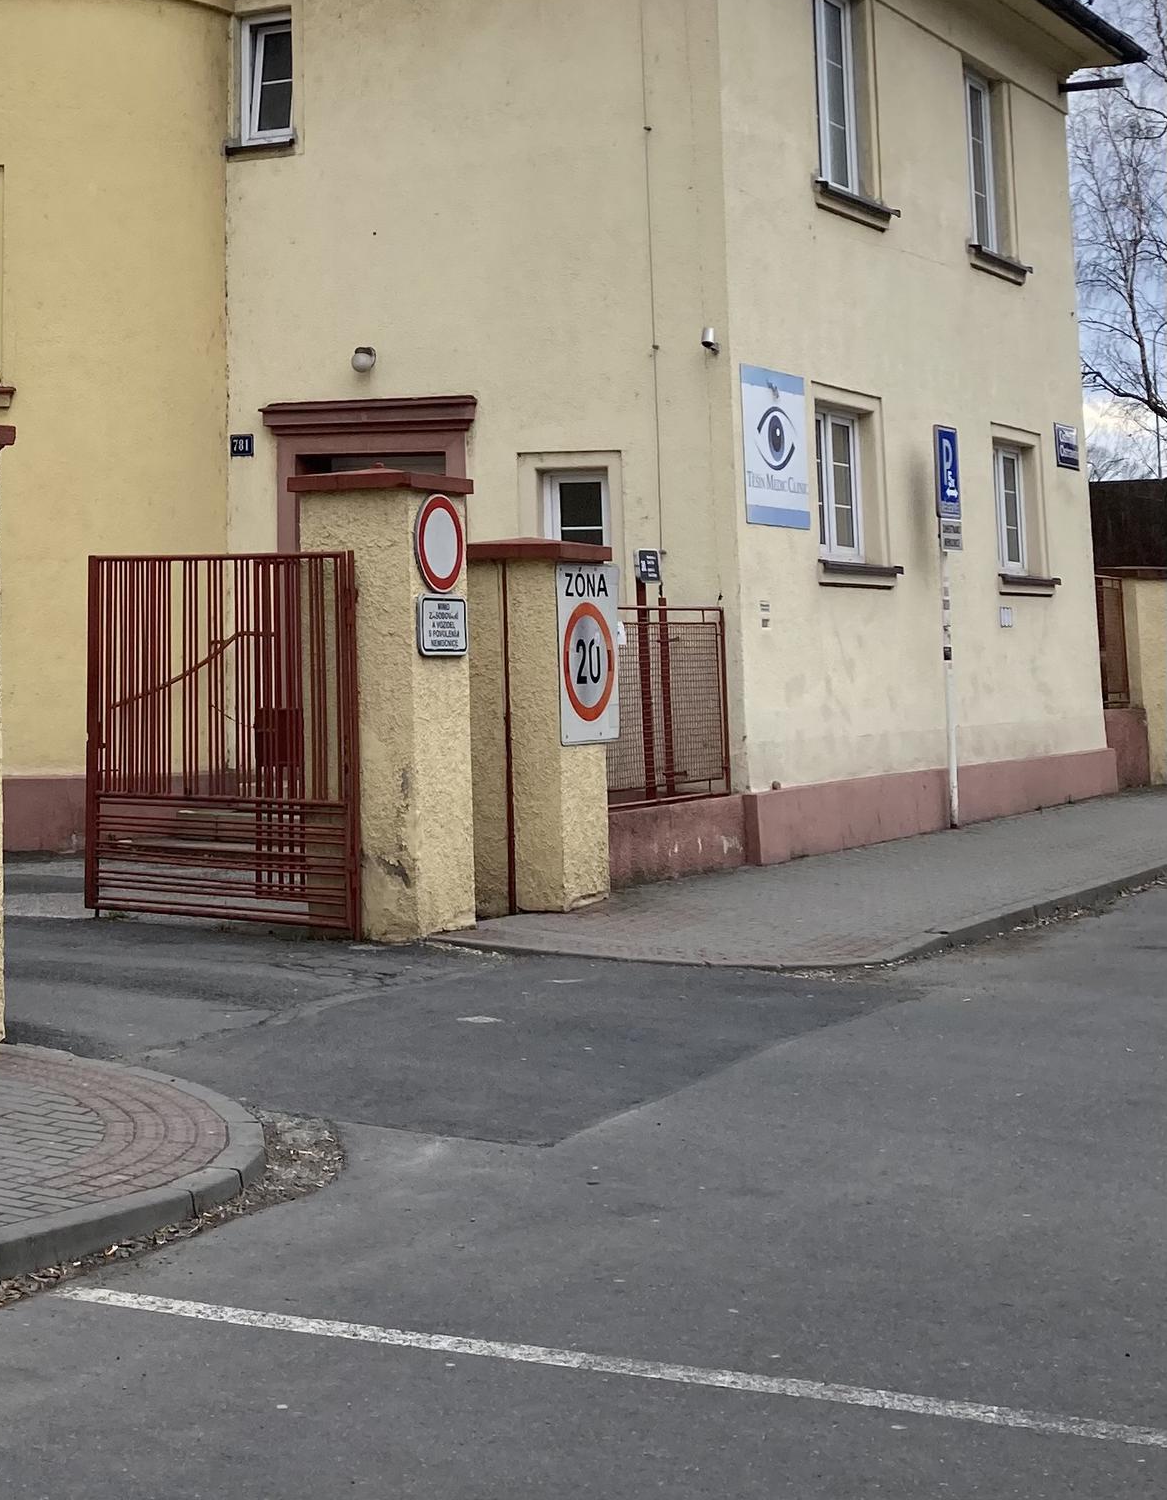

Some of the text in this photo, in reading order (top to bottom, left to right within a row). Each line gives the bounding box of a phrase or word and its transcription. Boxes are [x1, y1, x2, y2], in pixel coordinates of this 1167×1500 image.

[233, 438, 249, 452] 781
[766, 473, 788, 492] MEDIC
[565, 566, 609, 598] ZÓNA
[575, 638, 602, 685] 20
